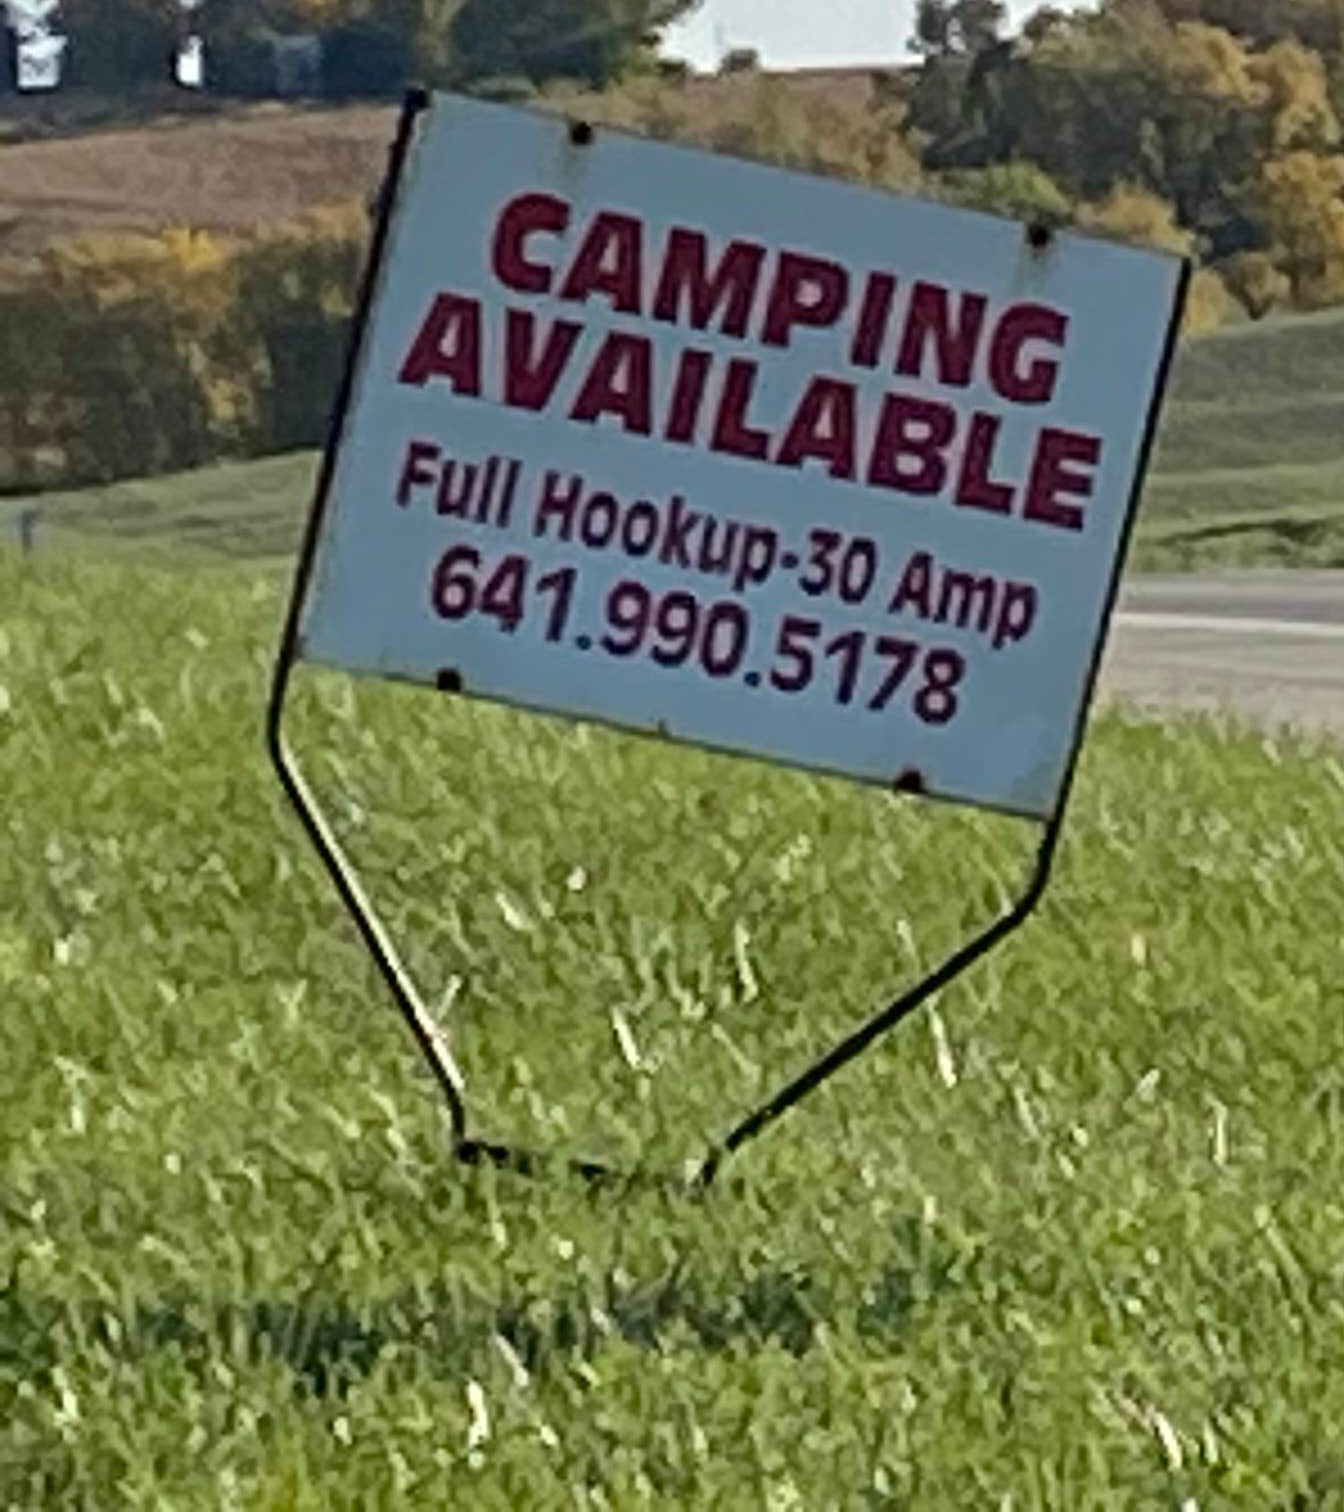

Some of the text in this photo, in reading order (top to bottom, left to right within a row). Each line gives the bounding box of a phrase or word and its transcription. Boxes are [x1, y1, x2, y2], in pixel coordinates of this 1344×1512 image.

[492, 192, 1067, 403] CAMPING
[399, 293, 1100, 530] AVAILABLE
[396, 442, 521, 528] Full
[888, 550, 1037, 649] Amp
[432, 546, 964, 724] 641.990.5178
